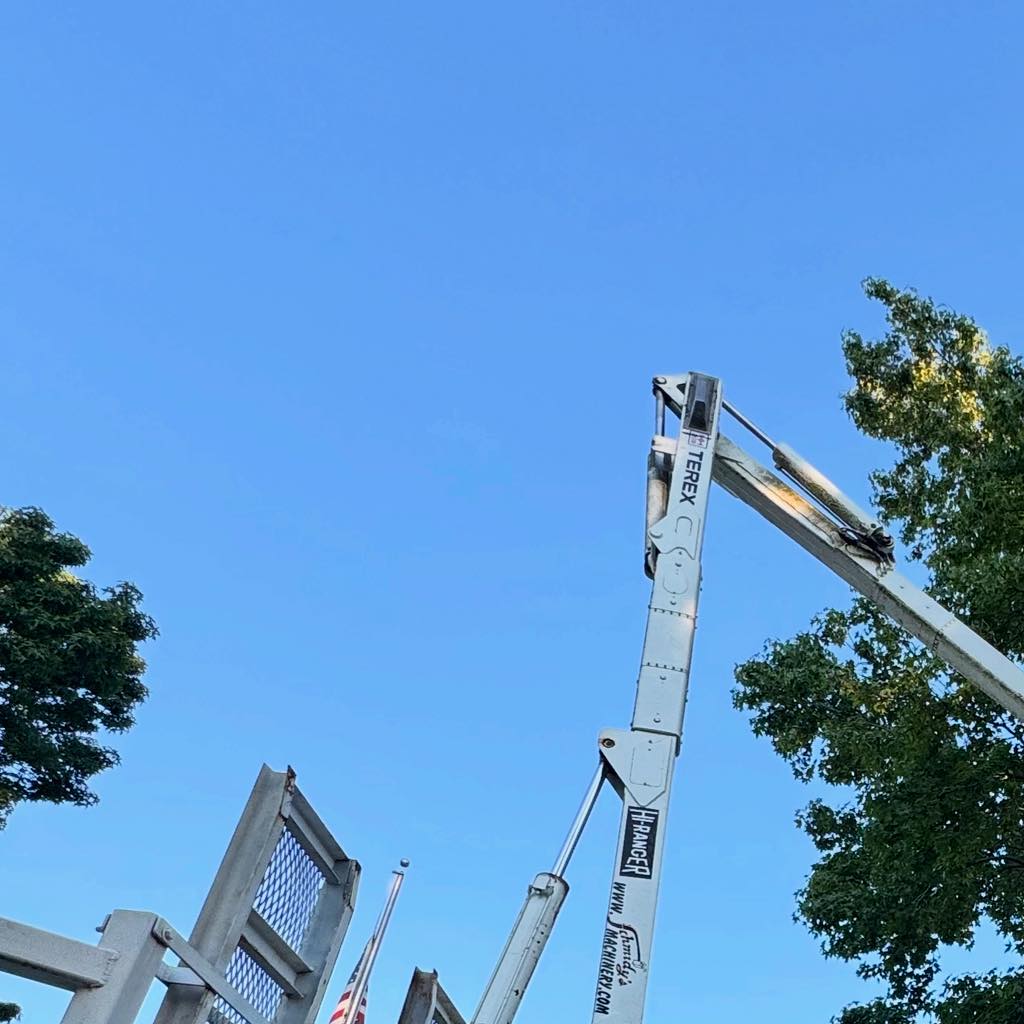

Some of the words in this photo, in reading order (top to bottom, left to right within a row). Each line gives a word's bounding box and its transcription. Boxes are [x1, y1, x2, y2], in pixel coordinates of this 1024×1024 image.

[679, 451, 704, 506] TEREX
[621, 807, 657, 877] HI-RANGER
[610, 881, 626, 915] WWW.
[595, 928, 619, 1016] MACHINERY.COM
